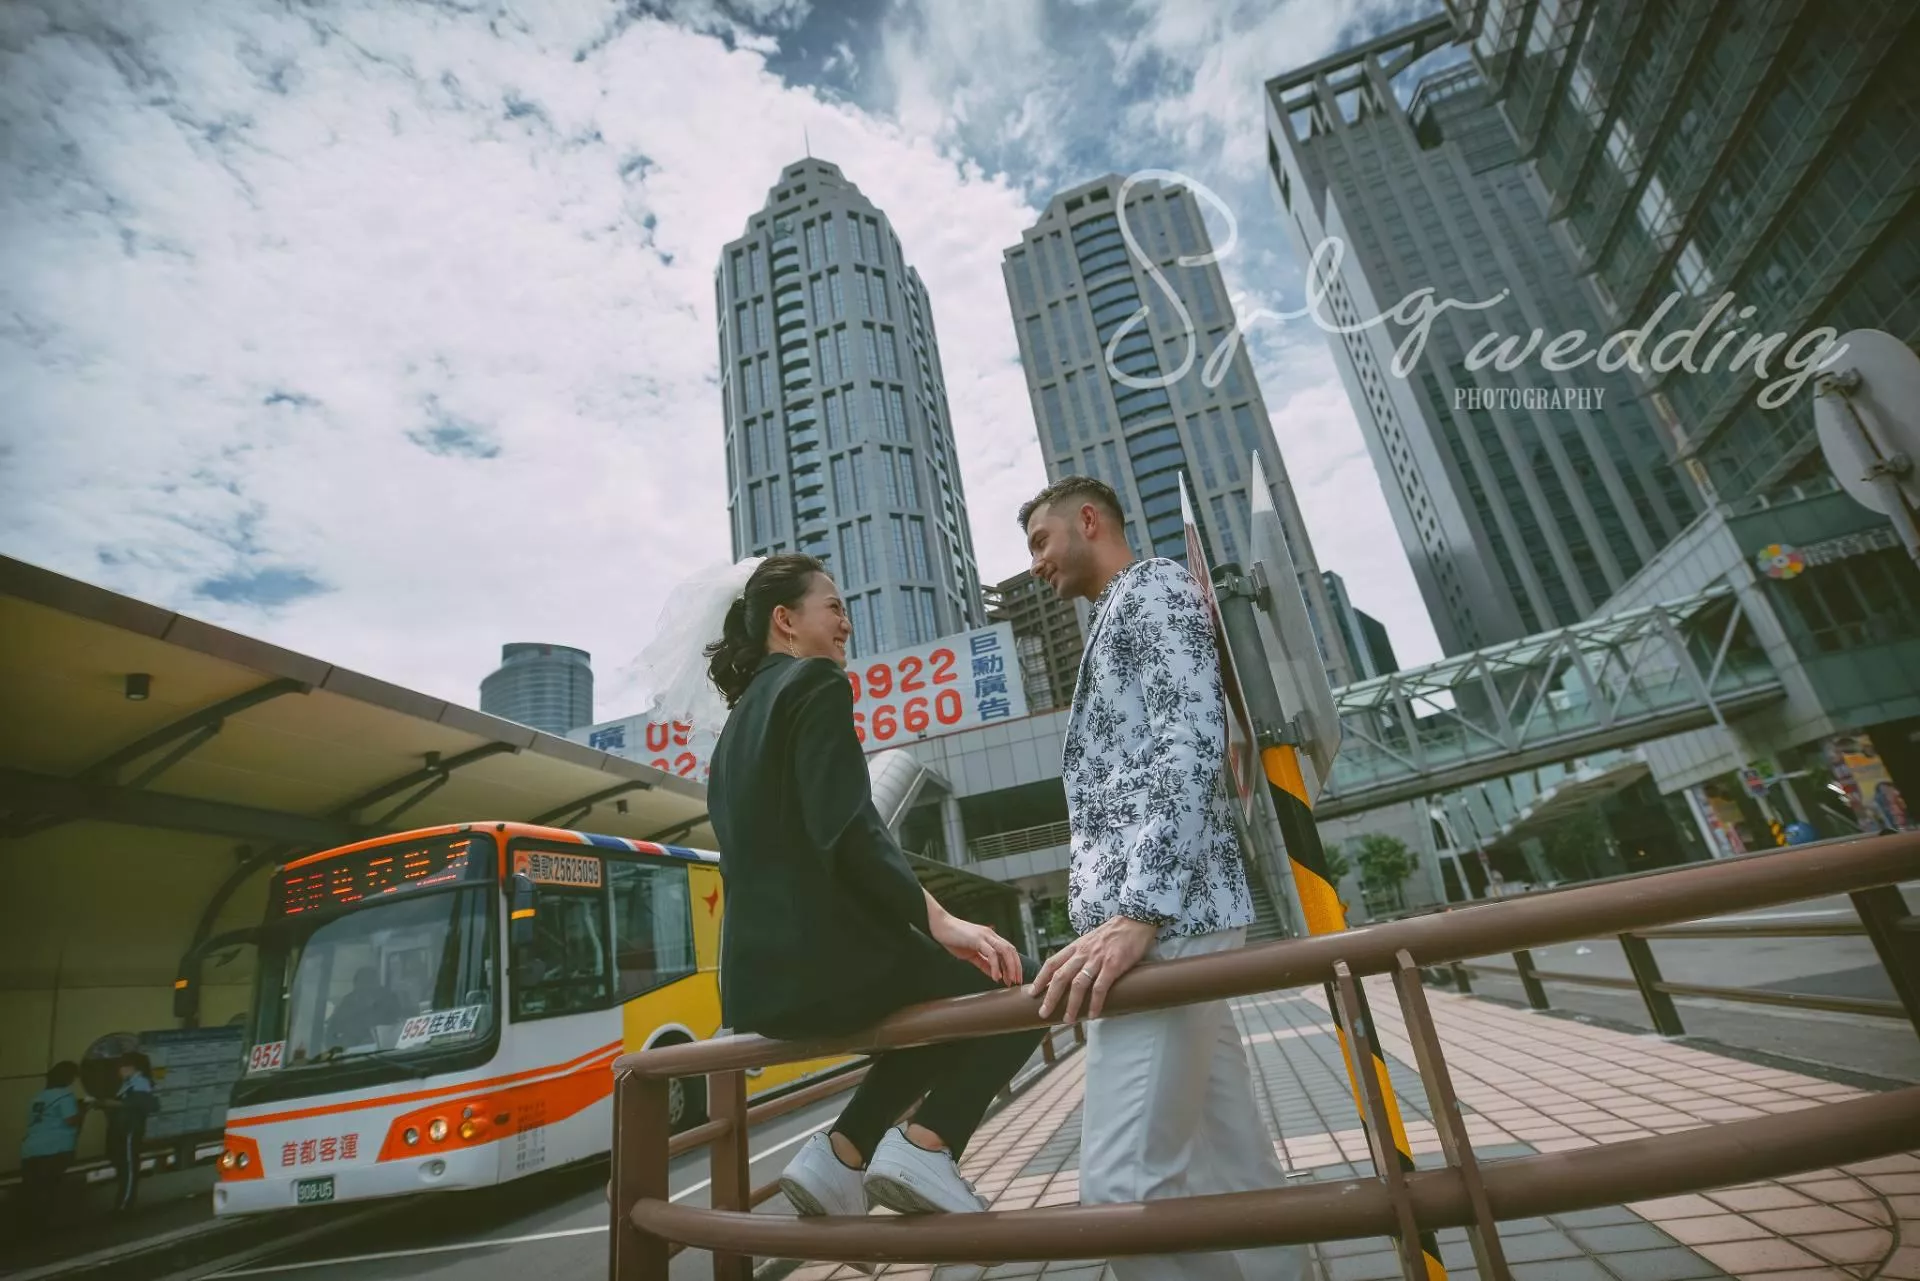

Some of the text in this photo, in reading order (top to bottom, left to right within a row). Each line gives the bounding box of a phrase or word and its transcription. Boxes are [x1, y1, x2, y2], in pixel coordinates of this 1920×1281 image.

[252, 1043, 285, 1069] 952
[281, 1133, 359, 1168] 首都客運
